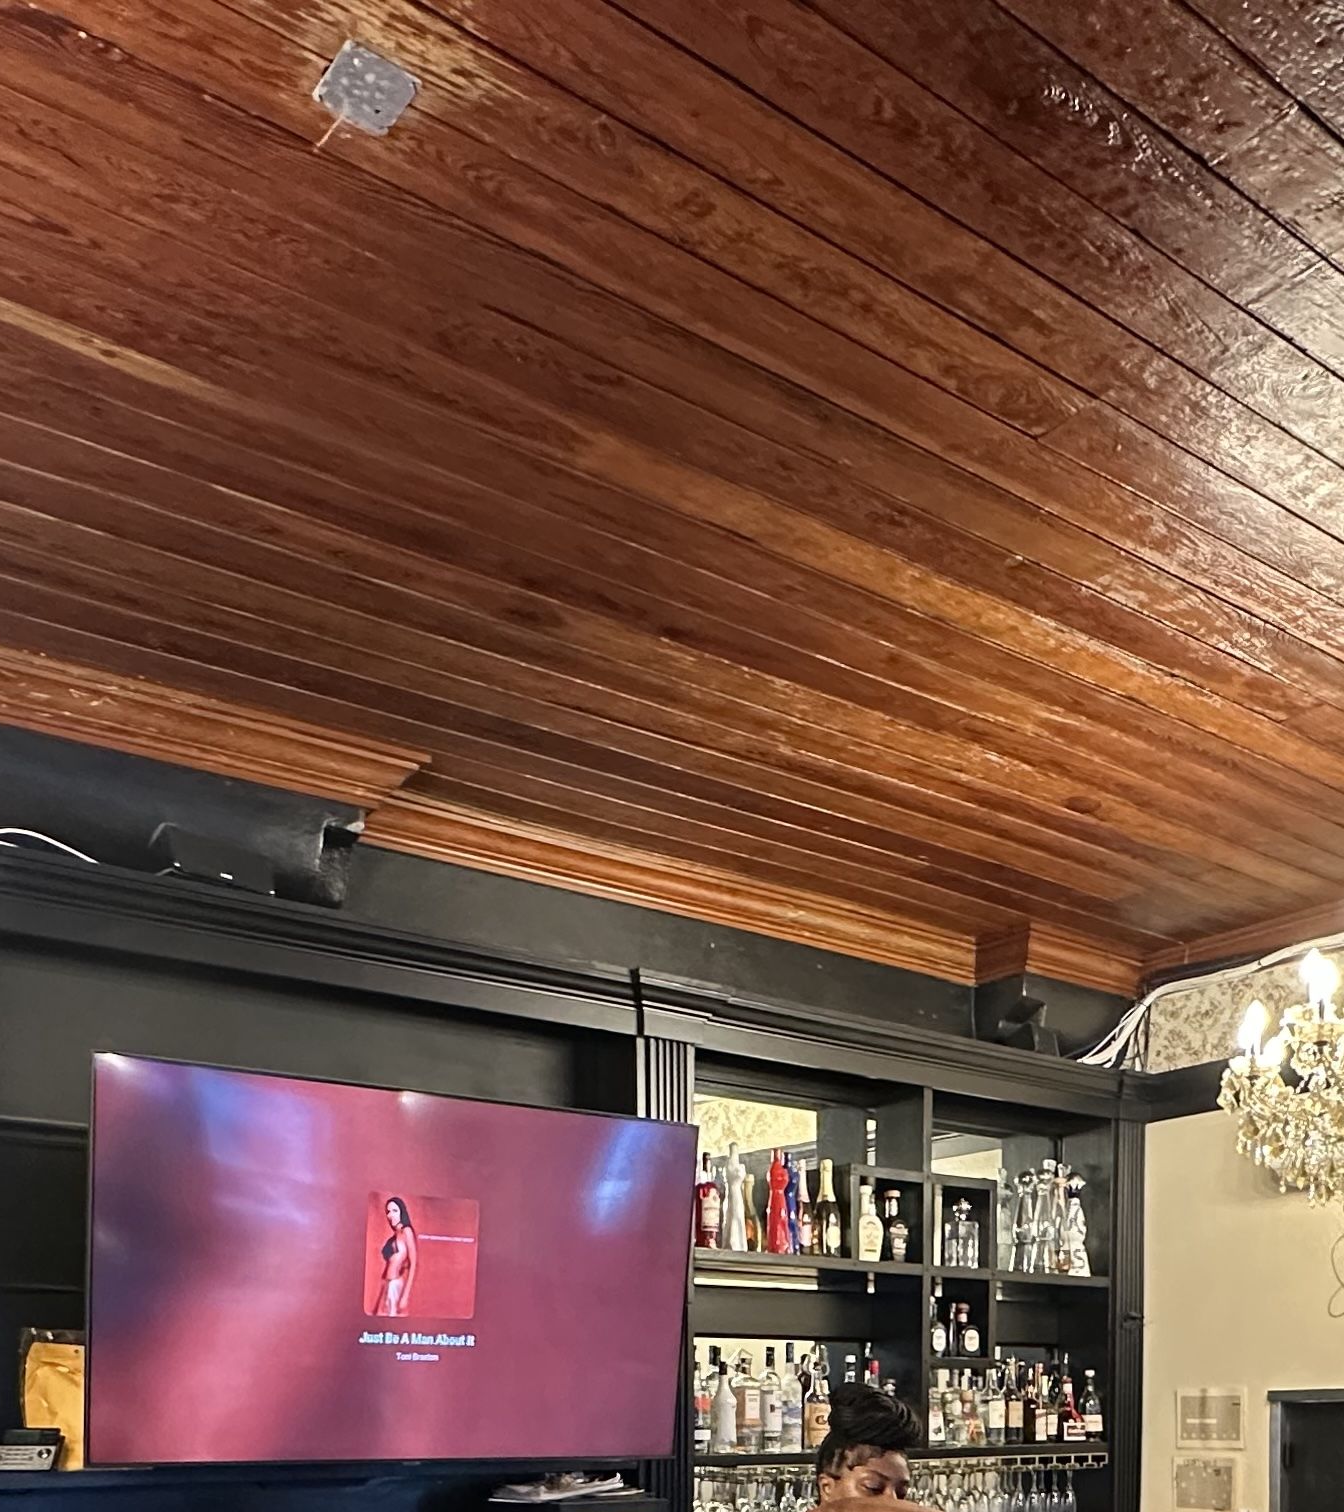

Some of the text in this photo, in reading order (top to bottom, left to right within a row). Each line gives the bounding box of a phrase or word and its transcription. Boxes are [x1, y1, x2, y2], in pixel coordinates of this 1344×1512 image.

[359, 1331, 384, 1344] Just
[385, 1331, 399, 1344] Be
[400, 1332, 409, 1344] A
[411, 1332, 434, 1345] Man
[435, 1333, 465, 1346] About
